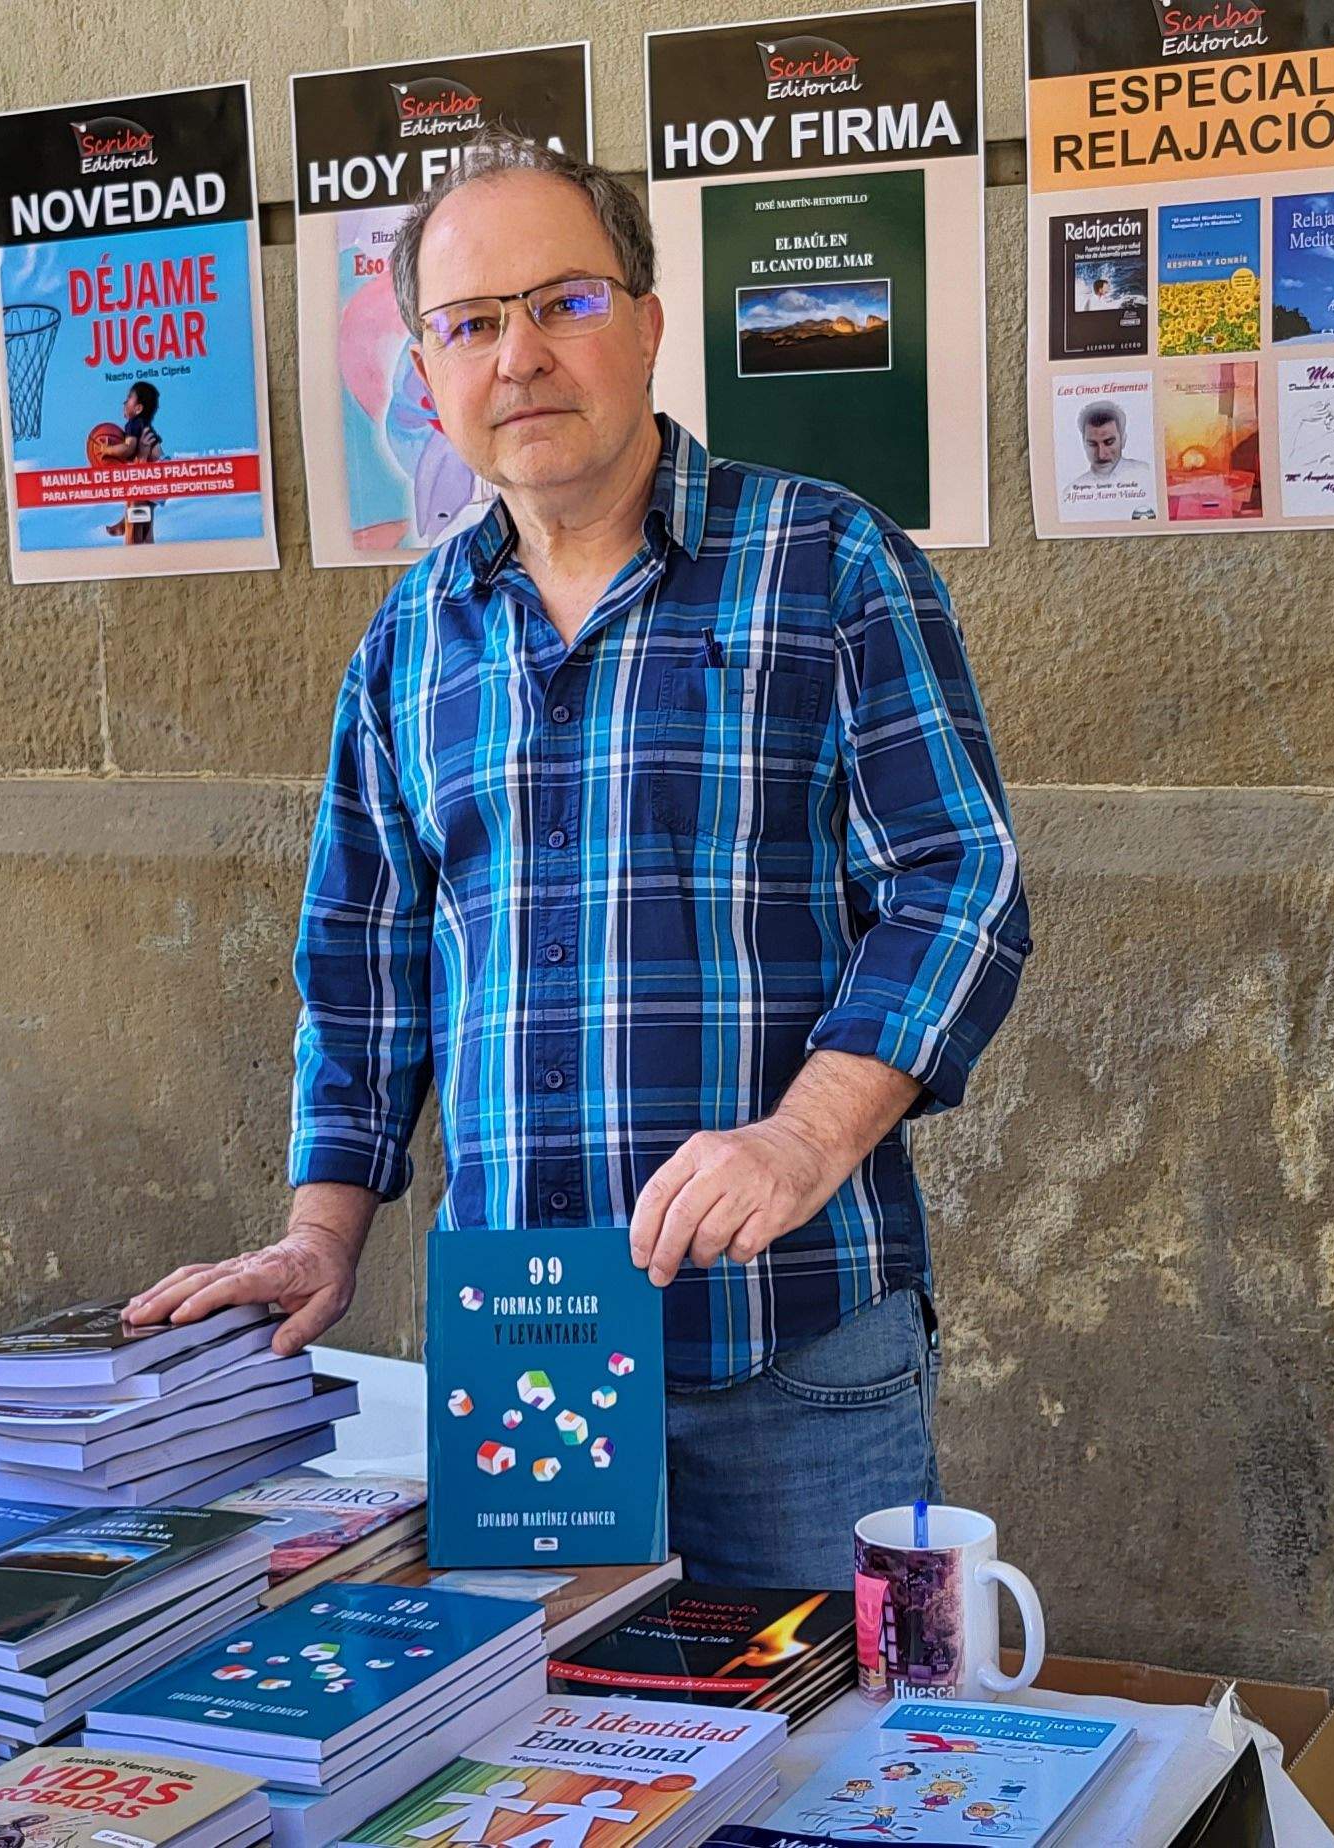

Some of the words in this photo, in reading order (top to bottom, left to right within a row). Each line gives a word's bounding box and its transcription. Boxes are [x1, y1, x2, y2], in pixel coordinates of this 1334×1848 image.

[1162, 4, 1265, 38] Scribo
[1162, 25, 1269, 56] Editorial
[768, 50, 860, 80] Scribo
[767, 73, 863, 100] Editorial
[399, 90, 483, 119] Scribo
[399, 113, 485, 138] Editorial
[663, 114, 776, 170] HOY
[790, 100, 963, 160] FIRMA
[82, 130, 155, 156] Scribo
[81, 150, 159, 175] Editorial
[308, 152, 408, 204] HOY
[11, 173, 226, 236] NOVEDAD
[754, 199, 776, 211] JOSÉ
[777, 193, 868, 210] MARTÍN-RETORTILLO
[775, 236, 792, 251] EL
[794, 231, 828, 250] BAÚL
[829, 234, 847, 248] EN
[1065, 217, 1141, 243] Relajación
[354, 254, 384, 276] Eso
[751, 260, 767, 274] EL
[769, 257, 813, 273] CANTO
[815, 255, 842, 270] DEL
[843, 253, 874, 269] MAR
[67, 253, 219, 315] DÉJAME
[84, 310, 208, 368] JUGAR
[105, 370, 133, 383] Nacho
[161, 363, 191, 380] Ciprés
[1075, 384, 1100, 395] Cinco
[1103, 382, 1148, 394] Elementos
[42, 473, 92, 488] MANUAL
[94, 471, 110, 484] DE
[112, 467, 162, 483] BUENAS
[164, 460, 233, 478] PRÁCTICAS
[42, 490, 67, 501] PARA
[68, 487, 110, 500] FAMILIAS
[112, 487, 125, 498] DE
[127, 484, 168, 497] JÓVENES
[170, 479, 235, 493] DEPORTISTAS
[1065, 491, 1094, 503] Alfonso
[1094, 491, 1116, 501] Acero
[528, 1257, 563, 1285] 99
[493, 1296, 541, 1315] FORMAS
[547, 1296, 562, 1314] DE
[567, 1295, 598, 1314] CAER
[494, 1326, 502, 1345] Y
[509, 1322, 598, 1345] LEVANTARSE
[291, 1488, 399, 1505] LIBRO
[477, 1512, 519, 1527] EDUARDO
[522, 1508, 567, 1526] MARTÍNEZ
[571, 1511, 616, 1526] CARNICER
[388, 1598, 429, 1614] 99
[679, 1599, 759, 1614] Divorcio,
[333, 1610, 386, 1623] FORMAS
[384, 1616, 406, 1626] DE
[404, 1619, 439, 1630] CAER
[638, 1614, 751, 1632] resurrección
[620, 1626, 646, 1635] Ana
[701, 1635, 734, 1643] Calle
[547, 1664, 573, 1674] Vive
[585, 1671, 610, 1680] vida
[612, 1674, 680, 1686] disfrutando
[681, 1678, 701, 1688] del
[894, 1680, 955, 1700] Huesca
[167, 1692, 214, 1702] EDUARDO
[259, 1704, 309, 1717] CARNICER
[532, 1706, 582, 1728] Tu
[581, 1711, 751, 1742] Identidad
[904, 1707, 986, 1722] Historias
[992, 1713, 1013, 1724] de
[1018, 1718, 1041, 1728] un
[1045, 1720, 1106, 1735] jueves
[938, 1723, 972, 1734] por
[974, 1724, 991, 1734] la
[997, 1728, 1045, 1740] tarde
[515, 1730, 706, 1763] Emocional
[61, 1756, 116, 1767] Antonio
[118, 1760, 198, 1781] Hernández
[510, 1754, 548, 1764] Miguel
[550, 1756, 581, 1767] Ángel
[584, 1761, 624, 1771] Miguel
[626, 1764, 664, 1774] Andrés
[18, 1765, 193, 1805] VIDAS
